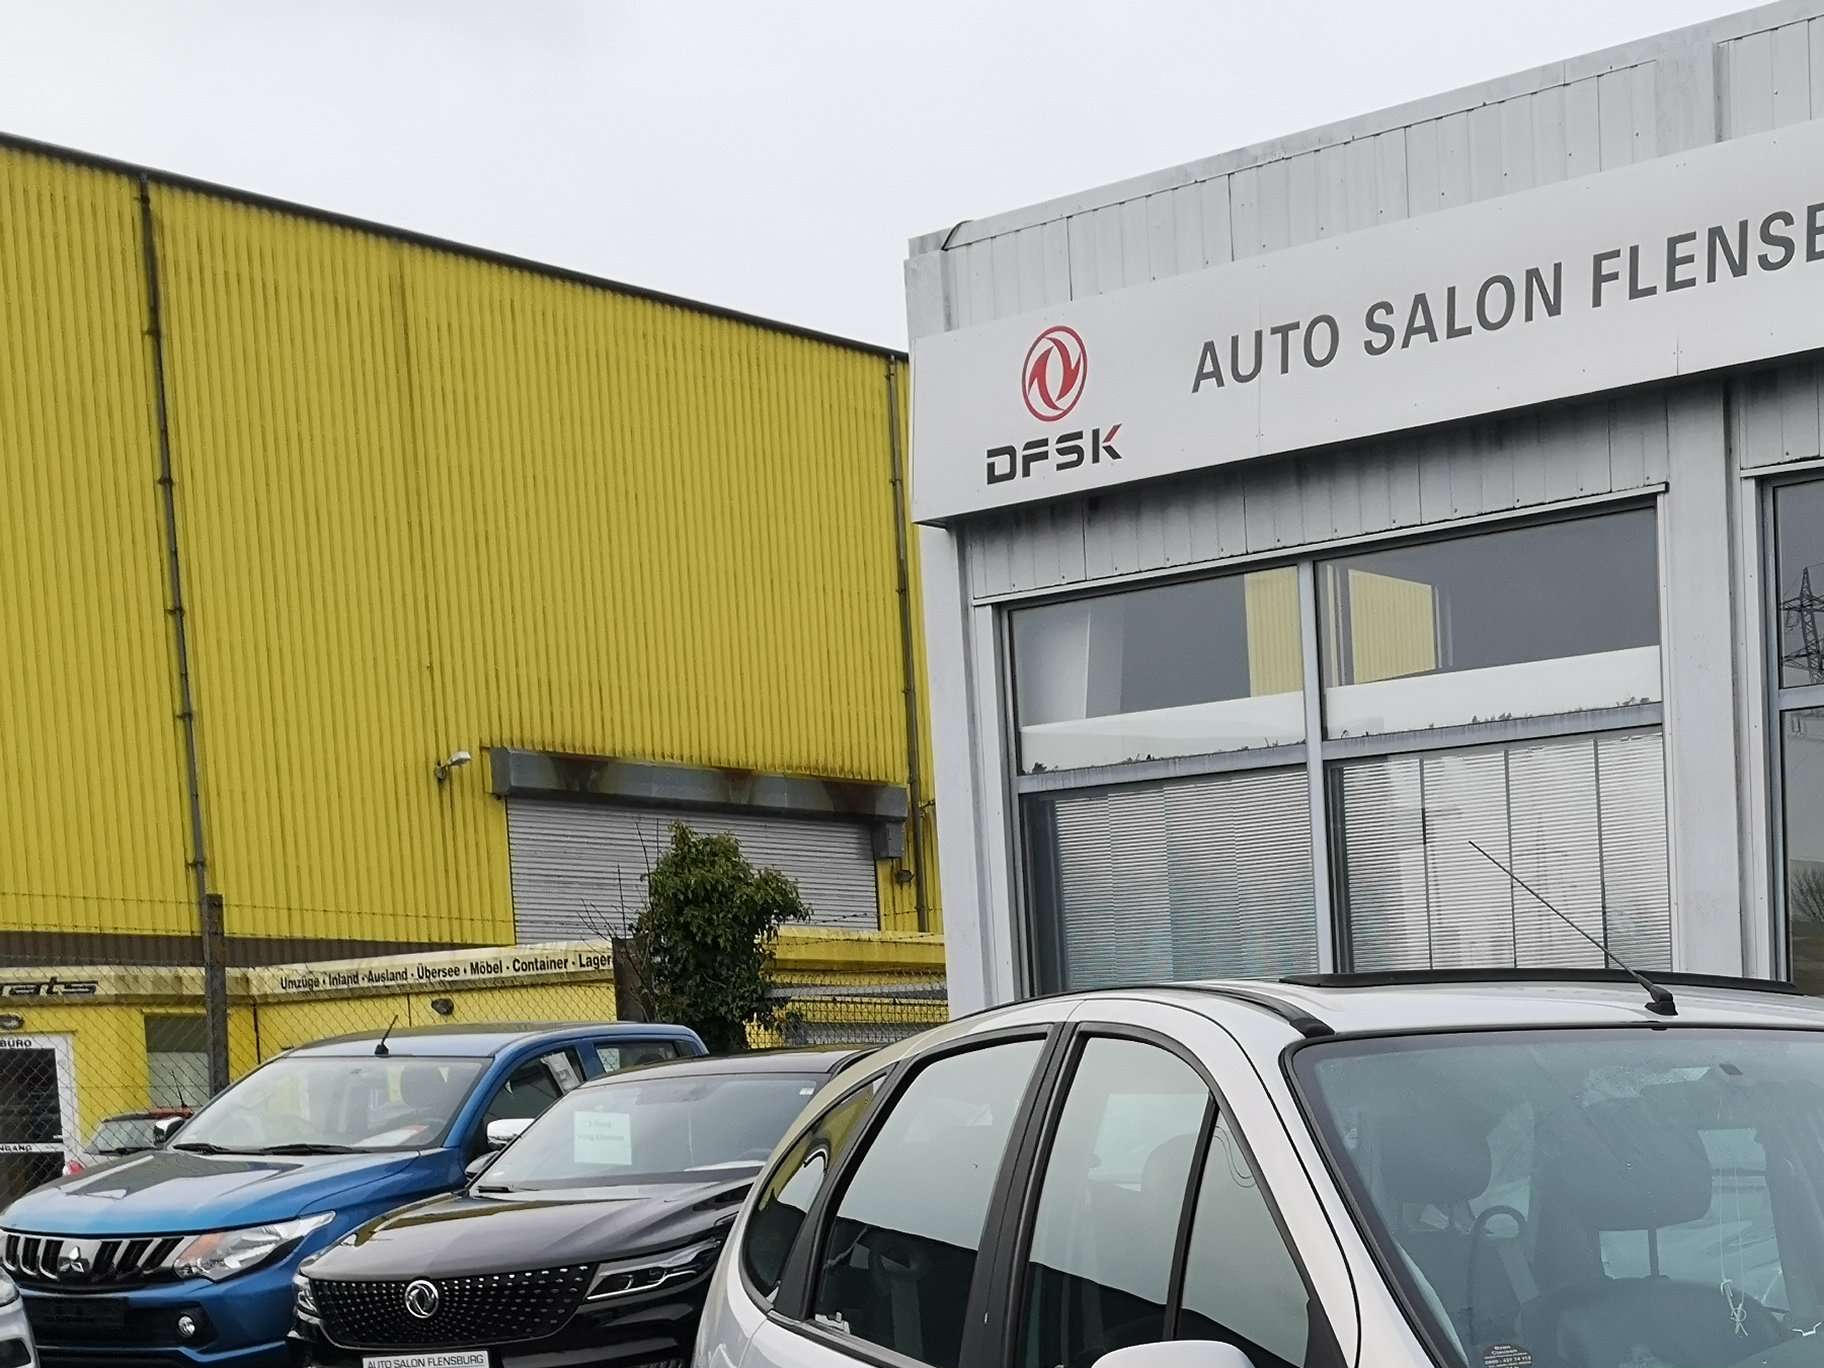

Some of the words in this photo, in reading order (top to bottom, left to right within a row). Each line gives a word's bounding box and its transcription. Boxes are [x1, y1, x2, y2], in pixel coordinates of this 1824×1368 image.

[1191, 314, 1339, 393] AUTO
[1364, 262, 1562, 355] SALON
[986, 424, 1122, 485] DFSK
[280, 975, 320, 990] Umzüge
[329, 971, 359, 987] Inland
[367, 967, 408, 984] Ausland
[416, 962, 460, 980] Übersee
[470, 960, 503, 976] Möbel
[513, 955, 568, 972] Container
[394, 1358, 425, 1368] SALON
[427, 1354, 484, 1367] FLENSBURG
